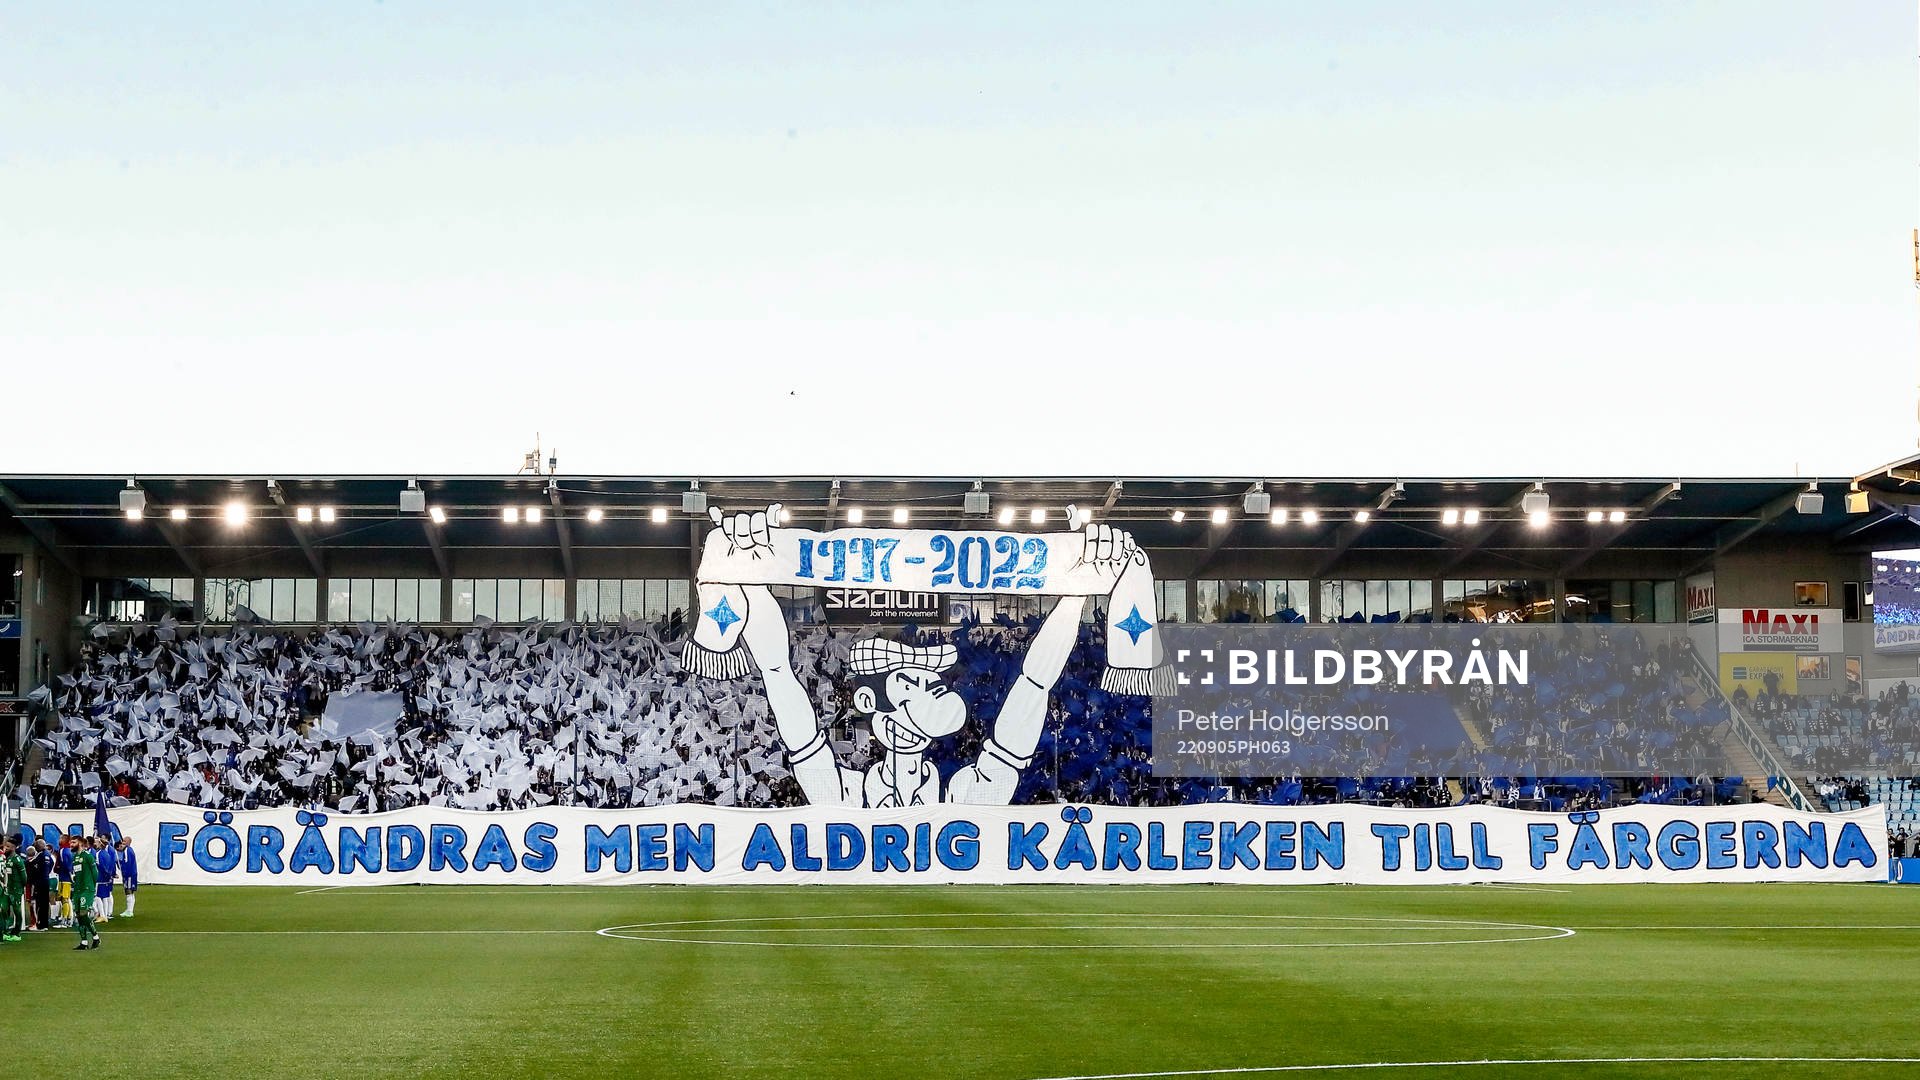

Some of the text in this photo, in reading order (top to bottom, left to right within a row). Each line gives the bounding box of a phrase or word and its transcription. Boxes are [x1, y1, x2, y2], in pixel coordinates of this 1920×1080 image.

[826, 588, 939, 608] stadium
[1688, 586, 1714, 611] MAXI
[869, 609, 939, 617] Join the movement
[1742, 609, 1819, 635] MAXI
[1757, 635, 1819, 643] STORMARKNAD
[158, 810, 558, 875] FÖRÄNDRAS
[585, 823, 716, 873] MEN
[742, 821, 981, 872] ALDRIG
[1008, 805, 1346, 871] KÄRLEKEN
[1370, 823, 1503, 871] TILL
[1528, 812, 1878, 871] FÄRGERNA
